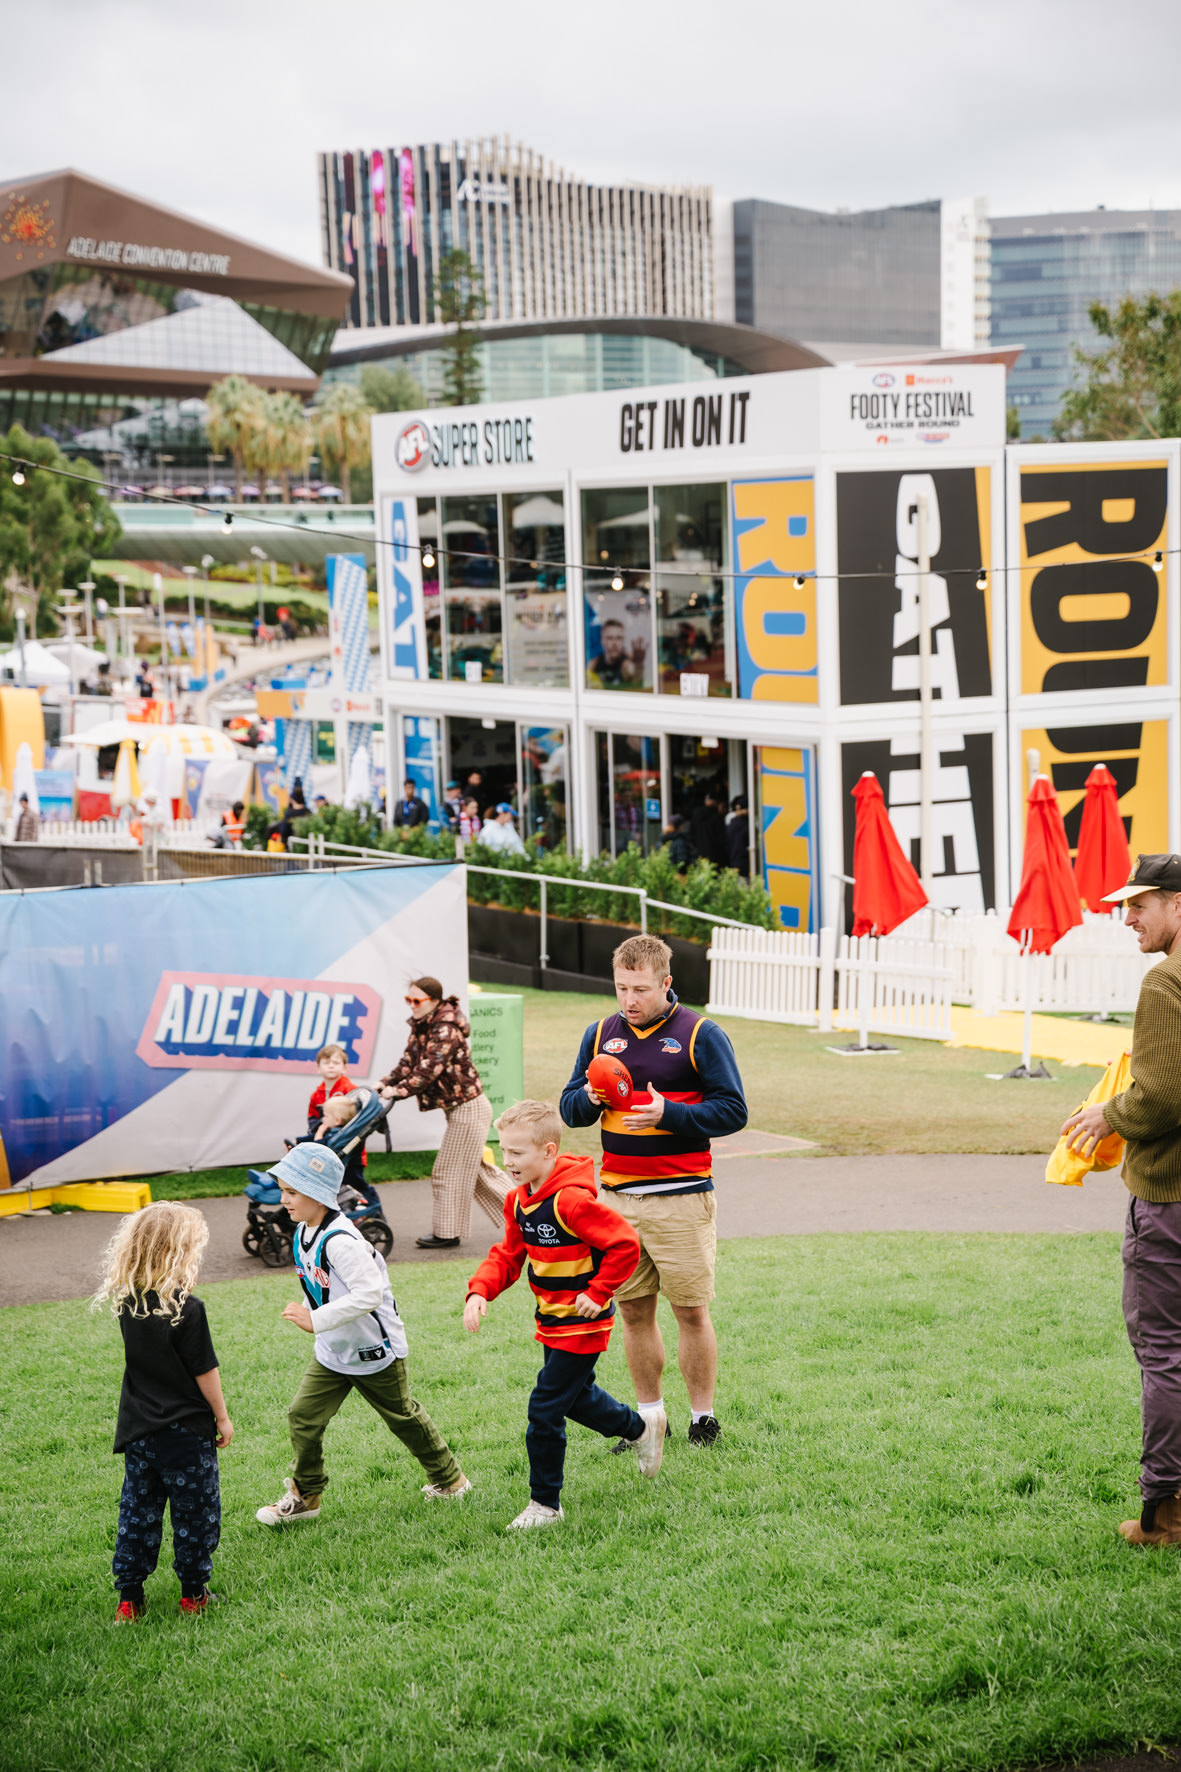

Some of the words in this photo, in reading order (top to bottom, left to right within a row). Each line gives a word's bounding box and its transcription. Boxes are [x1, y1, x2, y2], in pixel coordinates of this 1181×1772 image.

[66, 236, 123, 263] ADELAIDE
[122, 243, 189, 271] CONVENTION
[188, 251, 231, 275] CENTRE
[620, 401, 658, 453] GET
[663, 398, 686, 449] IN
[692, 394, 722, 447] ON
[729, 391, 750, 444] IT
[850, 393, 900, 419] FOOTY
[906, 391, 974, 418] FESTIVAL
[865, 421, 914, 430] GATHER
[918, 419, 960, 428] ROUND
[398, 424, 431, 464] AFL
[431, 422, 479, 467] SUPER
[485, 417, 534, 463] STORE
[153, 983, 356, 1051] ADELAIDE
[472, 1029, 497, 1038] Food
[605, 1040, 628, 1050] AFL
